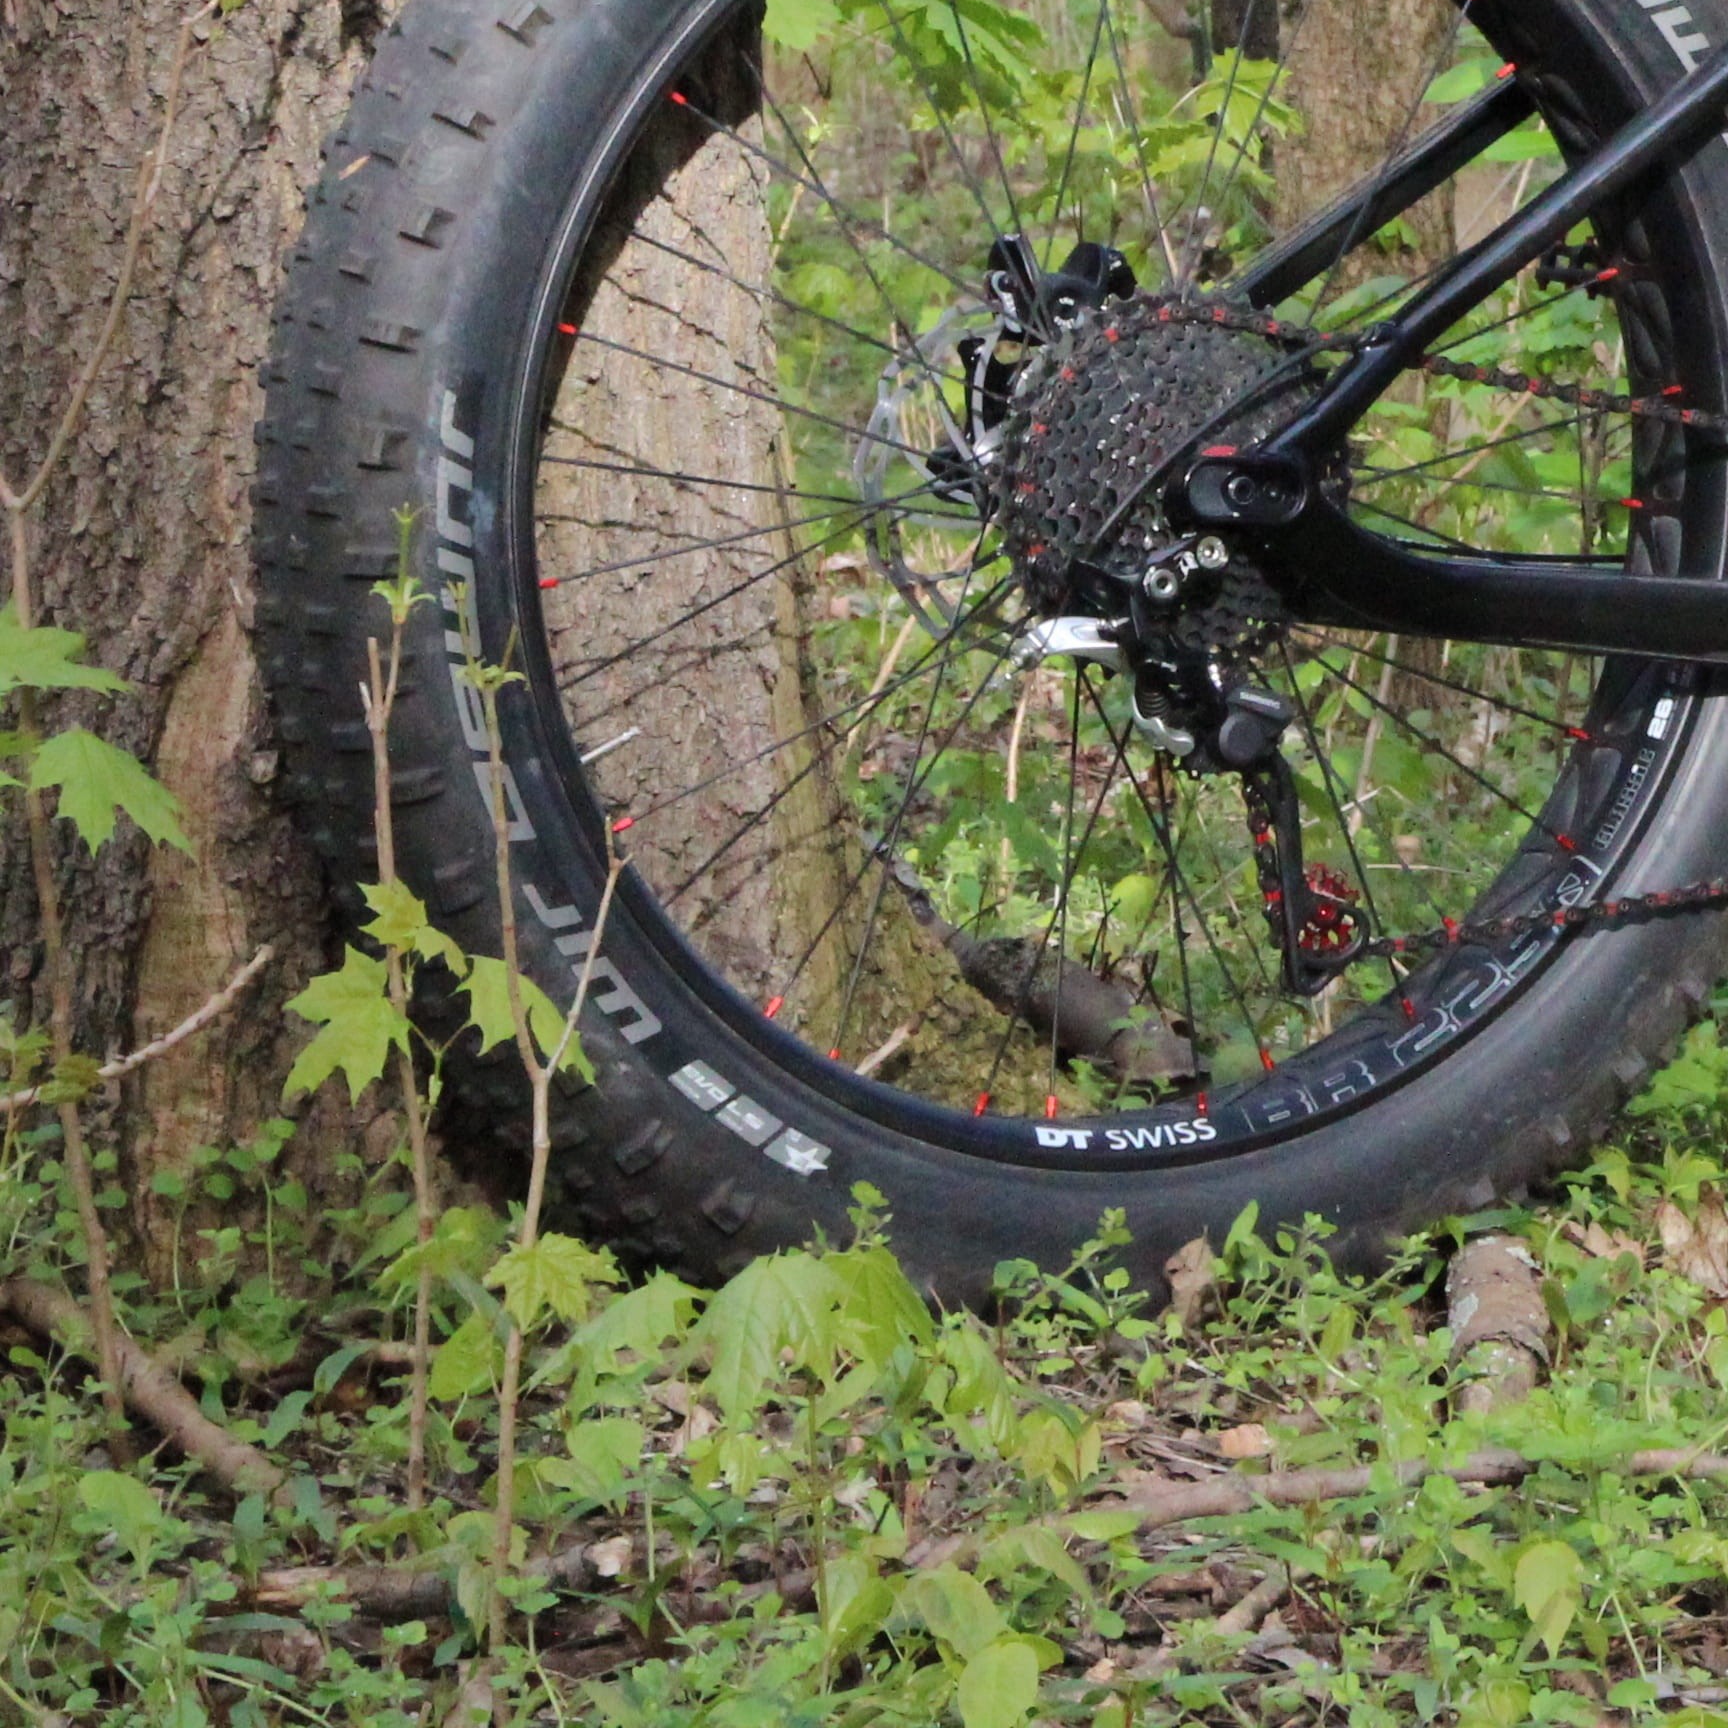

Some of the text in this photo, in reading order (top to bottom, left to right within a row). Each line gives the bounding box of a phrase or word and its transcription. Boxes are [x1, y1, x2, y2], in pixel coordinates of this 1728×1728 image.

[521, 883, 663, 1045] JIM
[1034, 1117, 1218, 1151] DT SWISS
